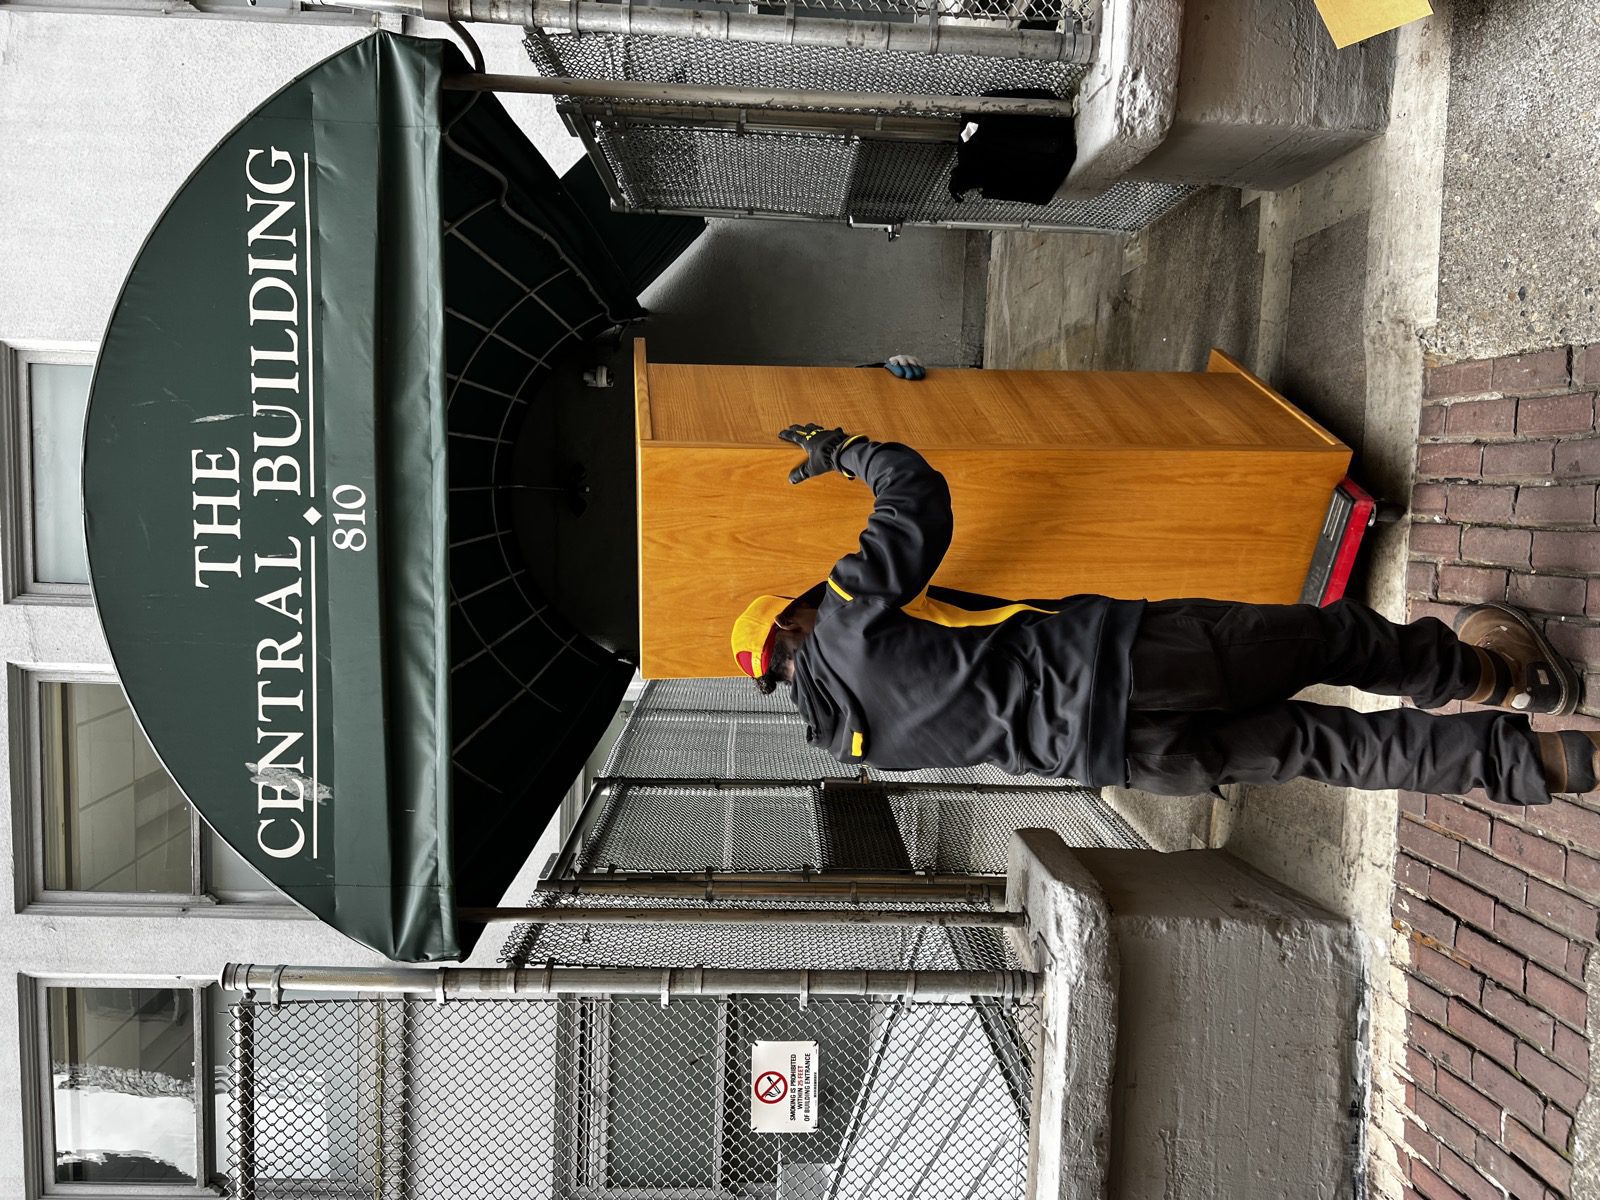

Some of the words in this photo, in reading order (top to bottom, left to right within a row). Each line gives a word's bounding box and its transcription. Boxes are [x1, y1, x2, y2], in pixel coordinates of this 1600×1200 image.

[246, 146, 301, 497] BUILDING
[191, 447, 241, 588] THE
[331, 484, 367, 552] 810
[254, 536, 305, 859] CENTRAL
